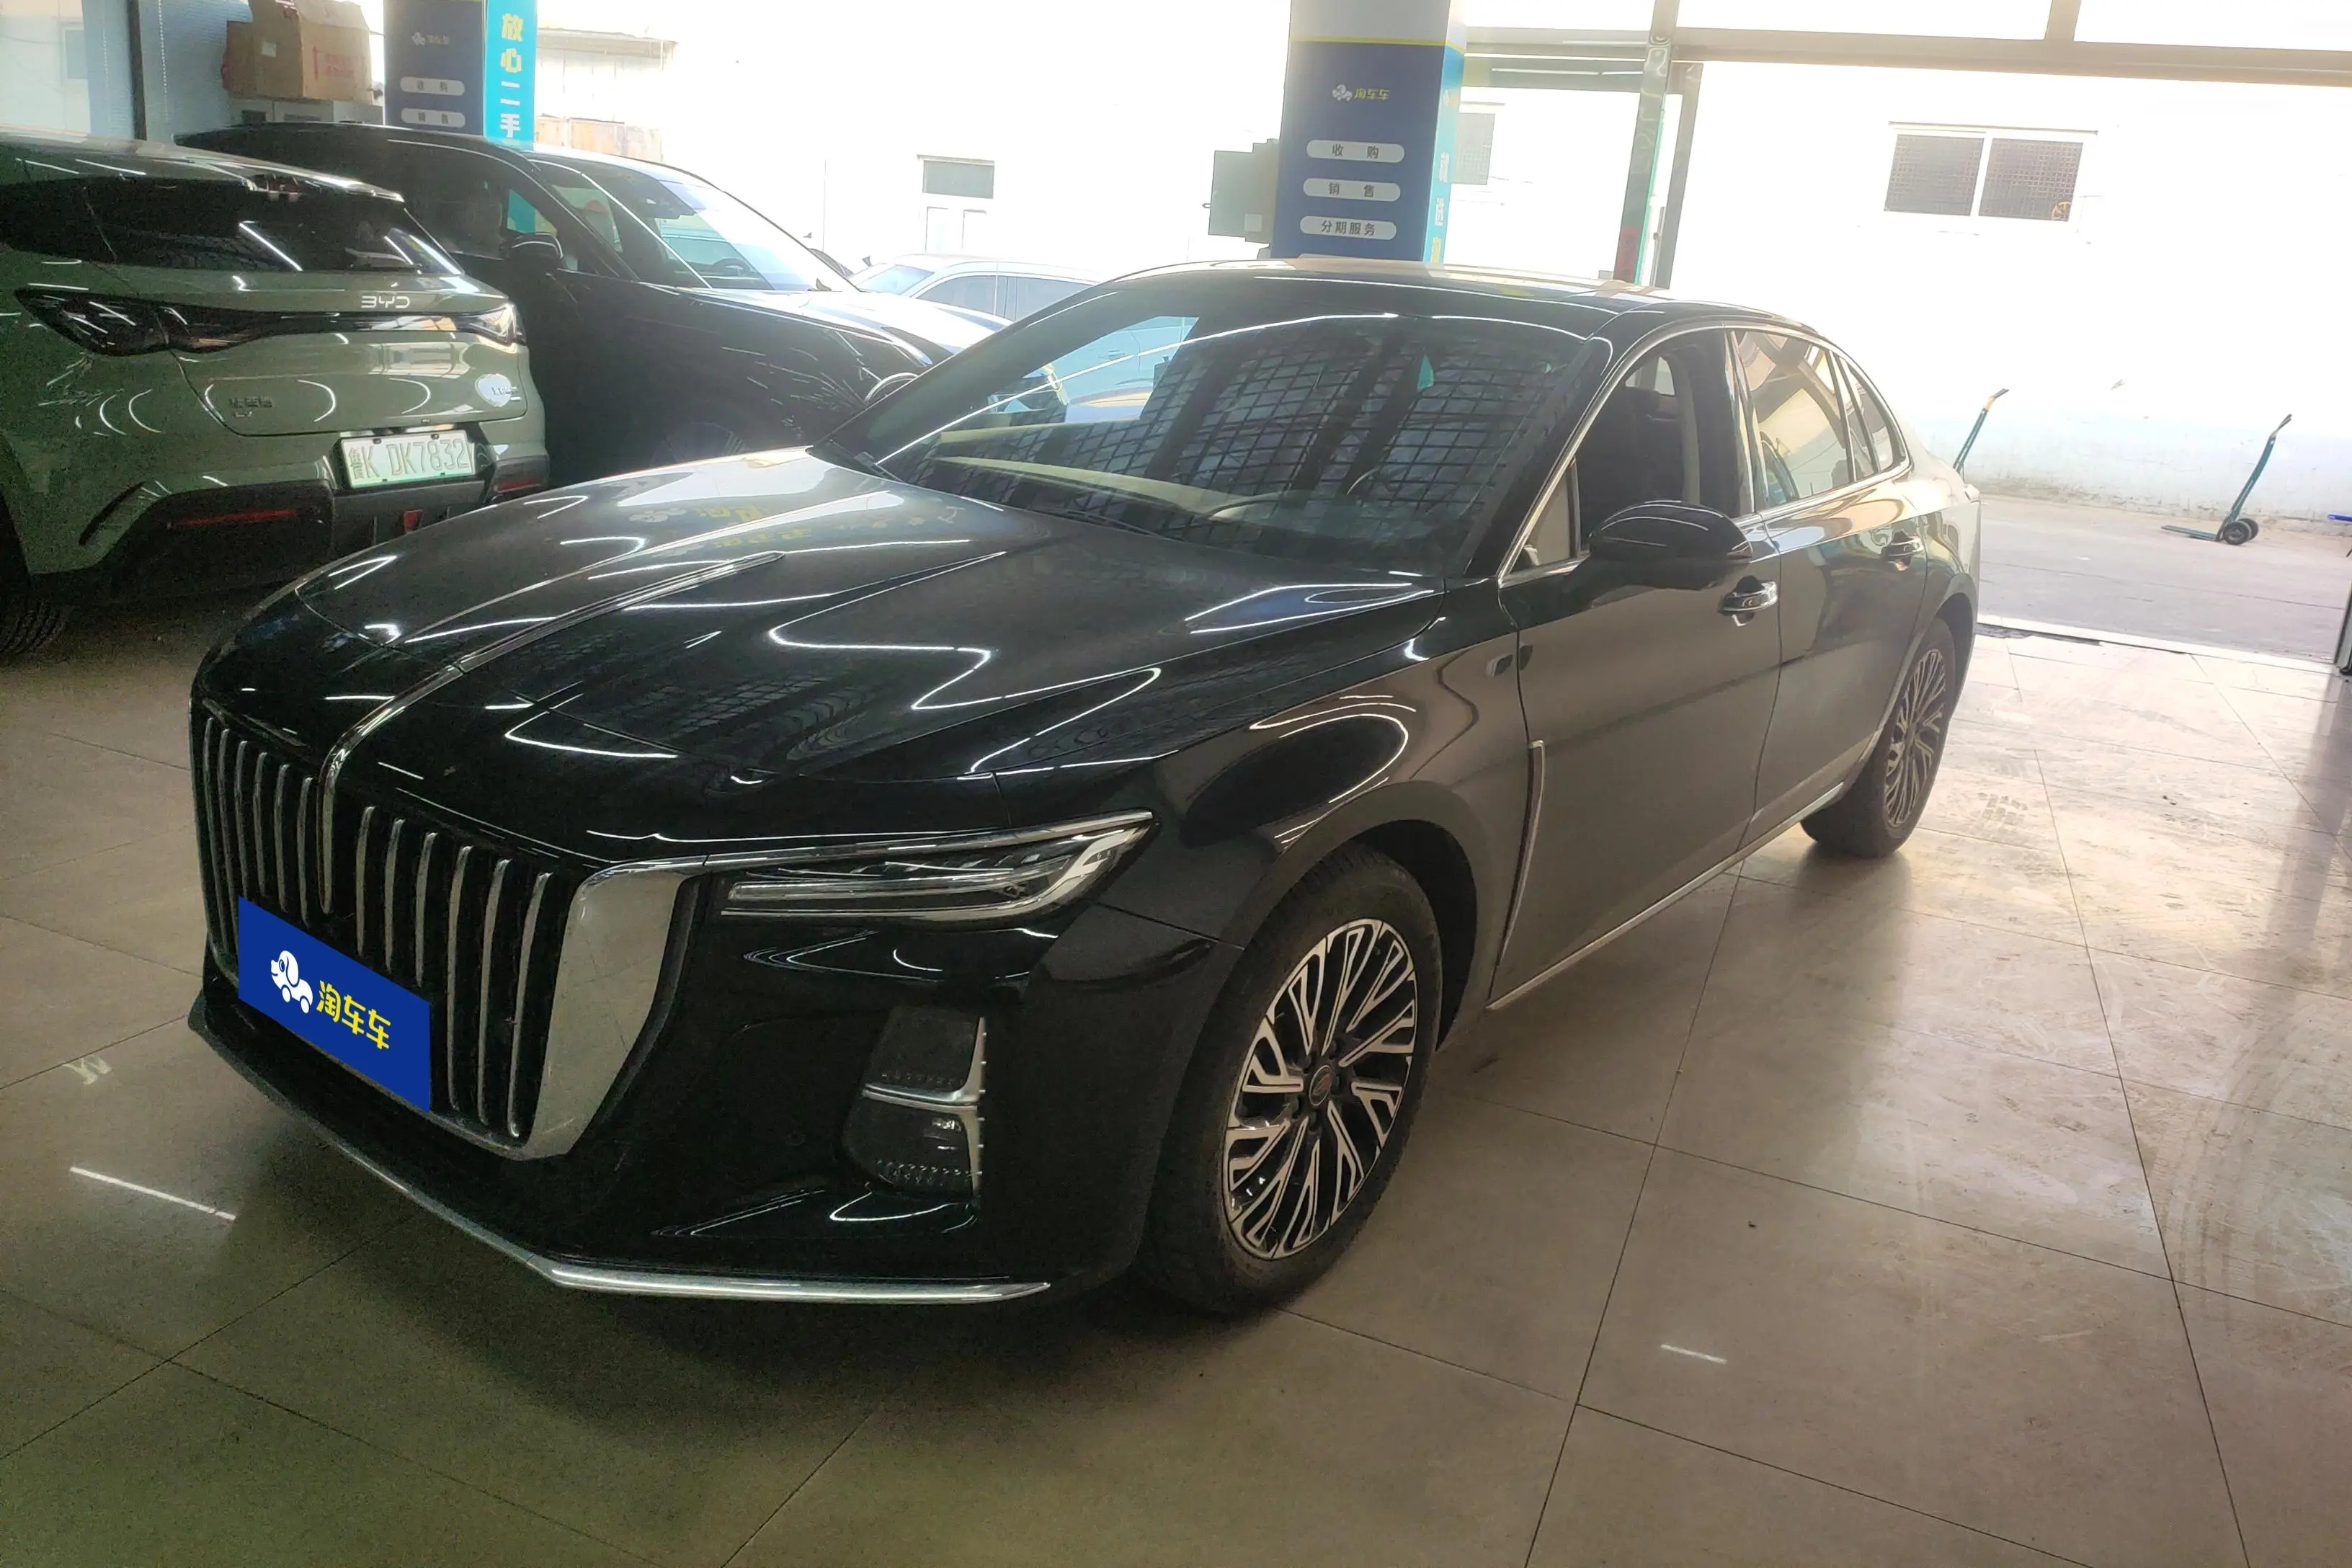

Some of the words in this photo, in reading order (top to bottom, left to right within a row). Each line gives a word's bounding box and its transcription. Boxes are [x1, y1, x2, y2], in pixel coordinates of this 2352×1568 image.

[1354, 87, 1390, 102] 淘车车
[1332, 143, 1378, 159] 收购
[1328, 182, 1375, 198] 销售
[1321, 220, 1376, 236] 分期服务
[361, 295, 410, 308] BYD
